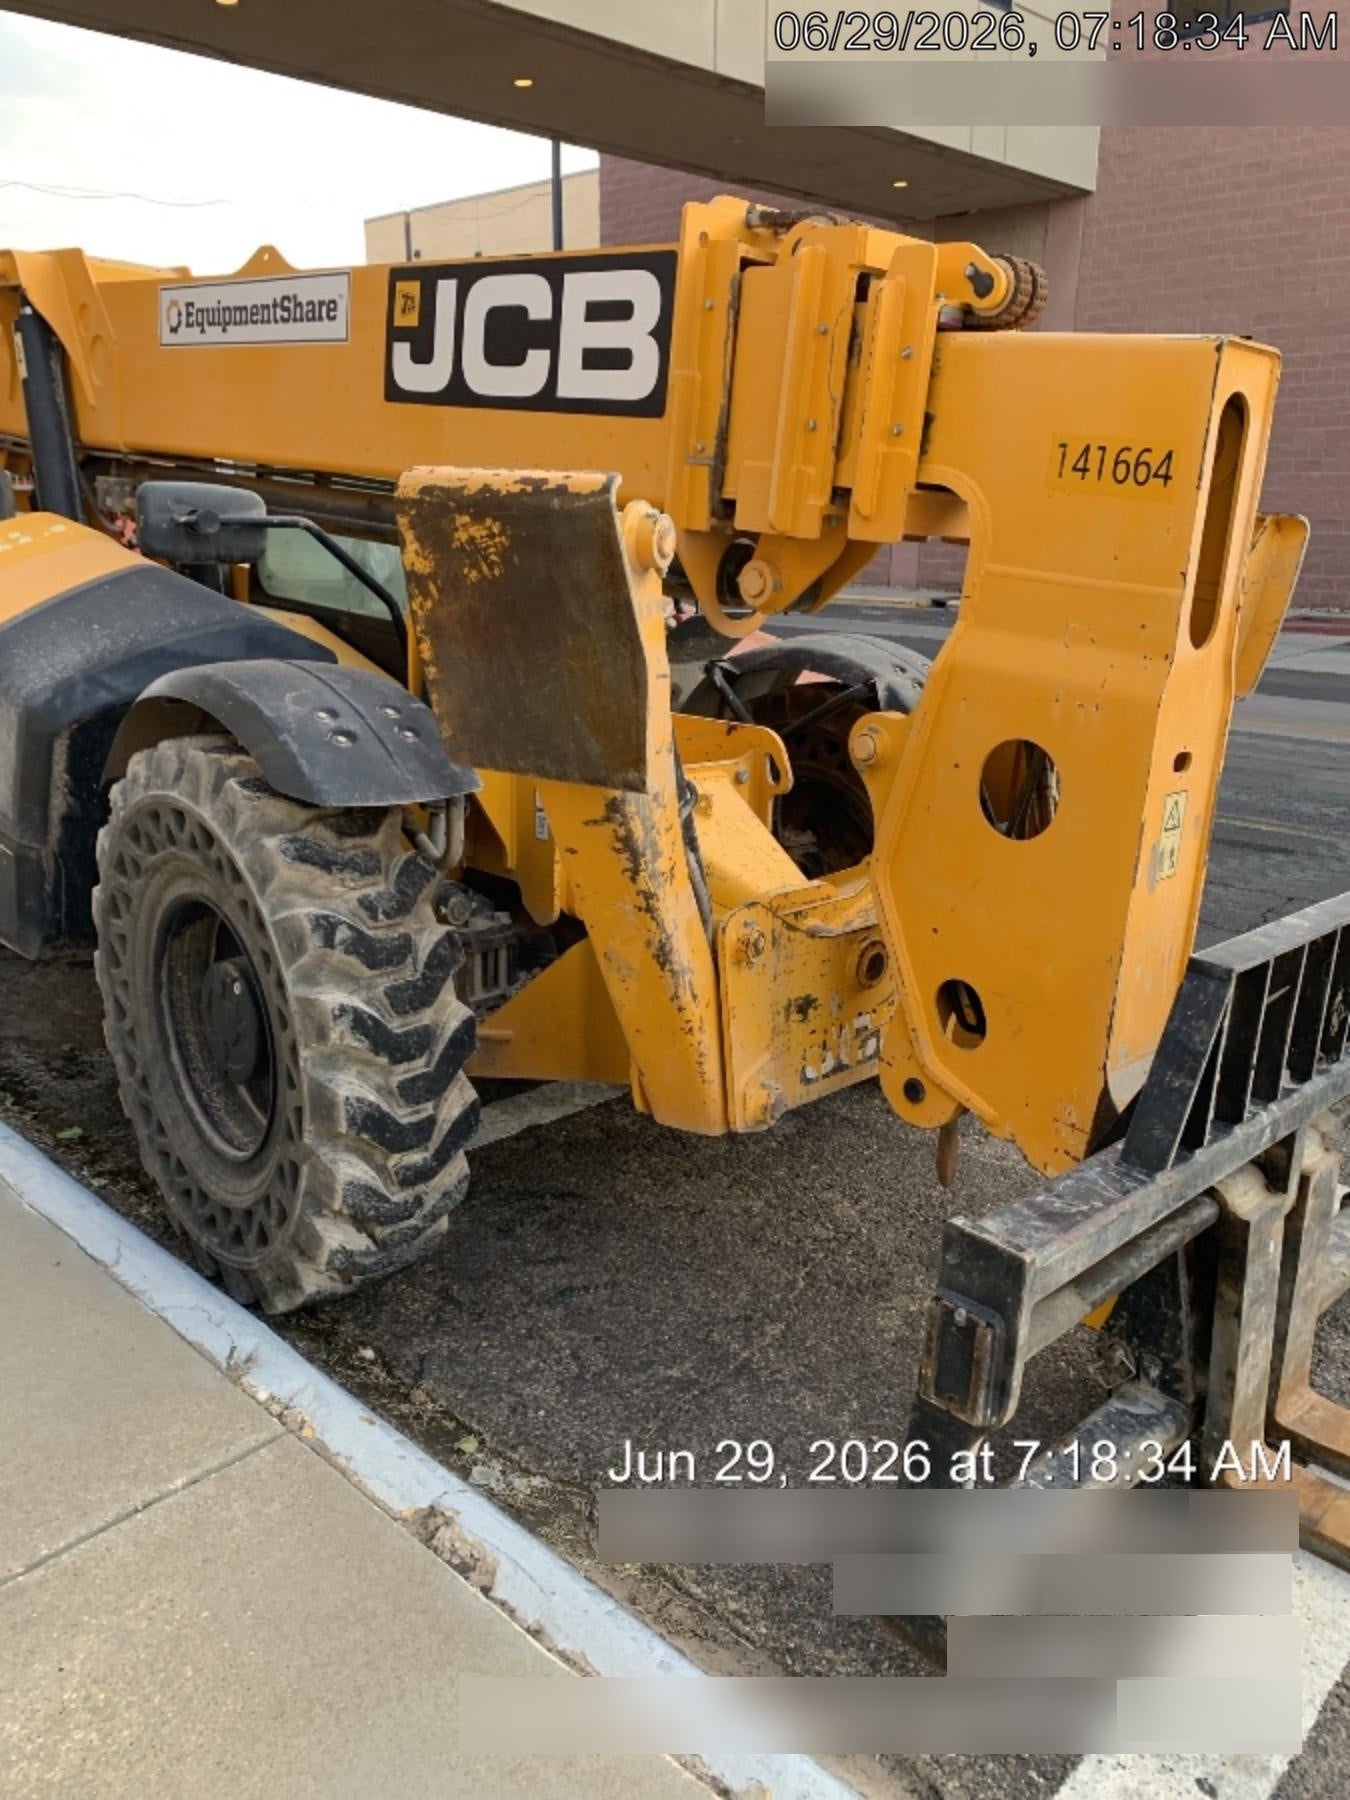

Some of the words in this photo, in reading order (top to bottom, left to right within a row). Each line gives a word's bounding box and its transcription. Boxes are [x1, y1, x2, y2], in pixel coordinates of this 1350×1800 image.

[185, 297, 338, 331] EquipmentShare
[392, 269, 662, 401] JCB
[1058, 442, 1174, 488] 141664
